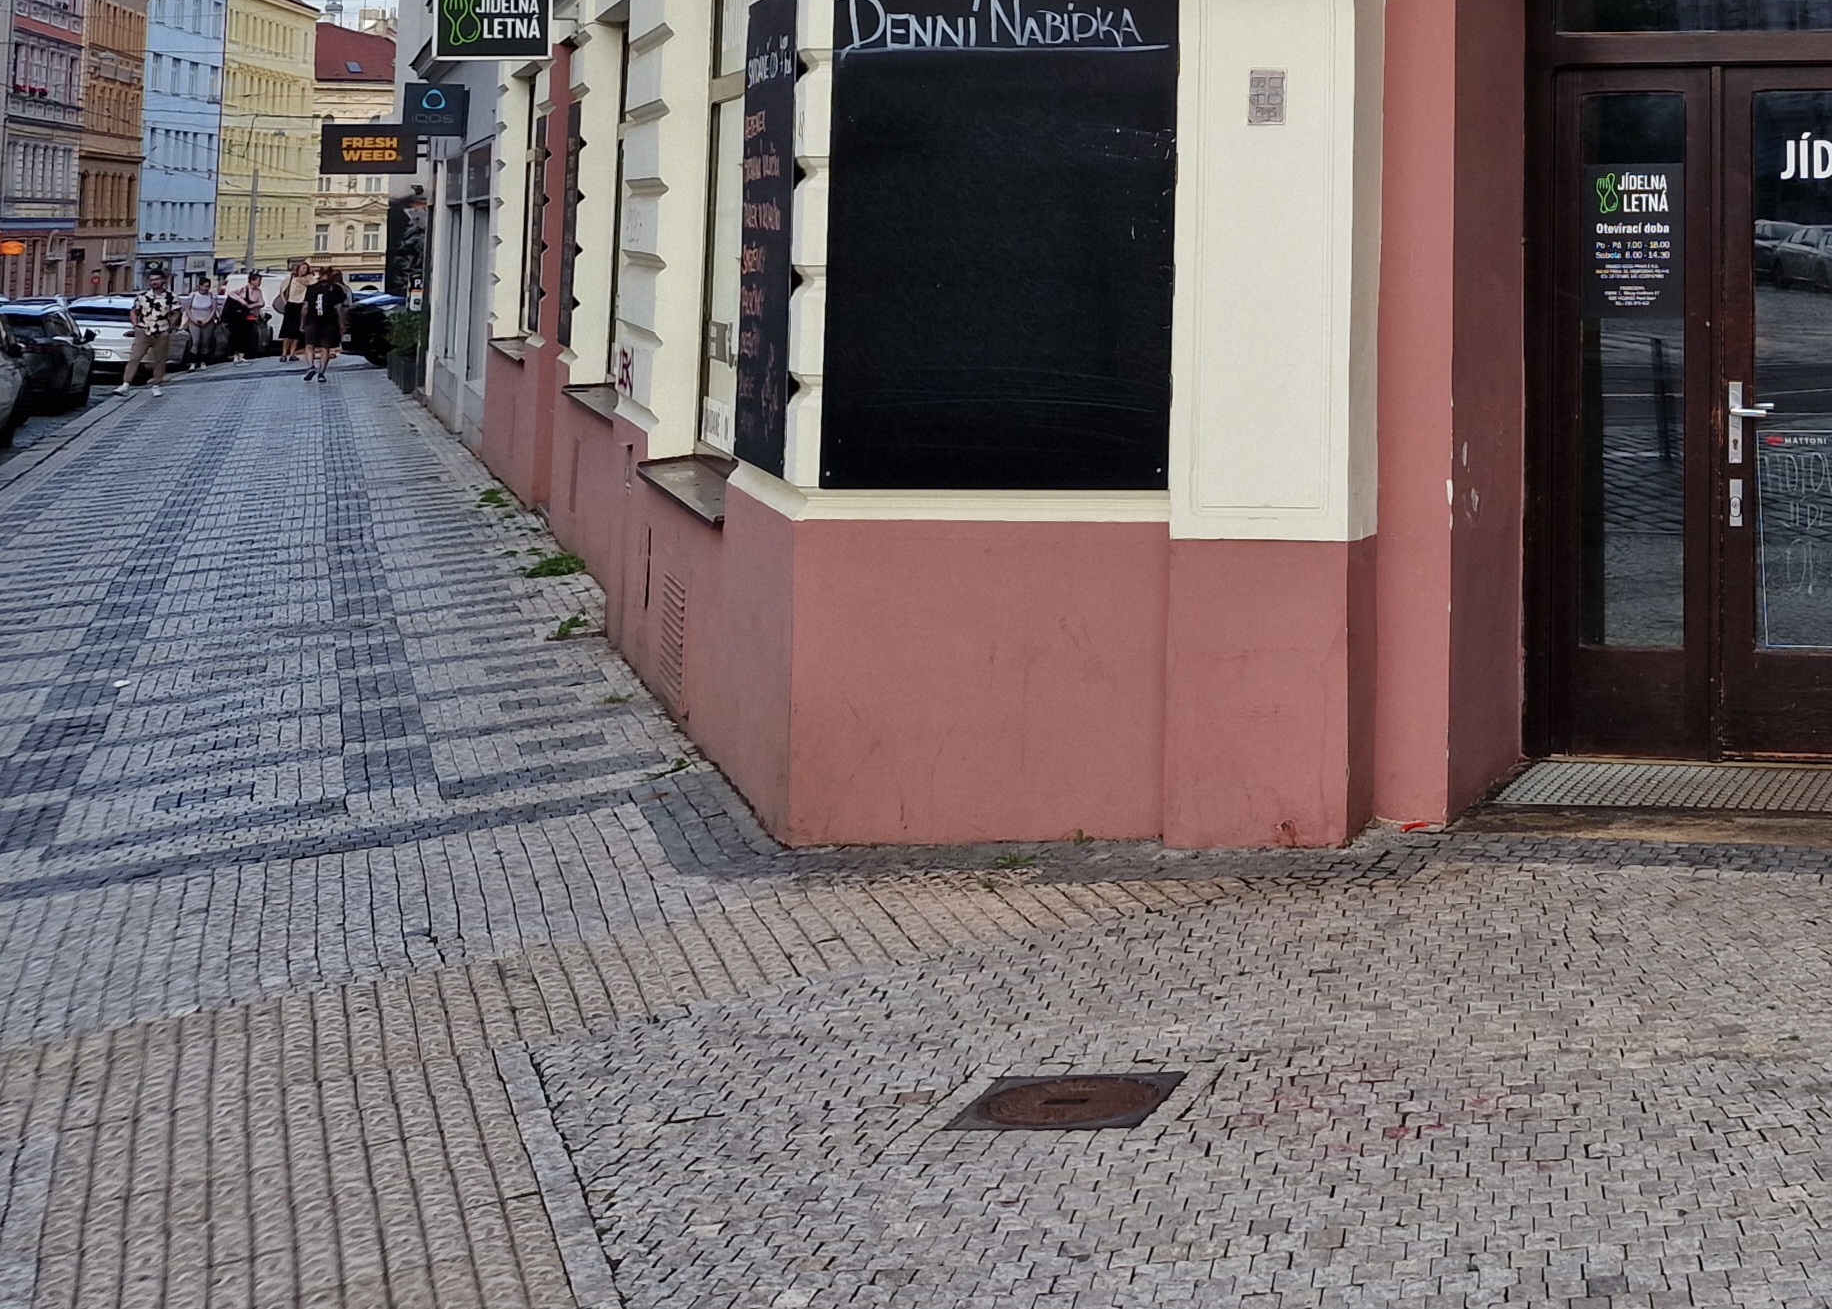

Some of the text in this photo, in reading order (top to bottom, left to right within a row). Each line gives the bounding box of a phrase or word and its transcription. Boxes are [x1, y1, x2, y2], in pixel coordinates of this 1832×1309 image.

[482, 14, 541, 39] LETNÁ
[411, 113, 454, 123] IQOS
[341, 137, 398, 148] FRESH
[1617, 172, 1668, 190] JÍDELNA
[1623, 190, 1669, 212] LETNÁ
[1596, 222, 1670, 233] Otevírací doba
[1784, 437, 1827, 445] MATTONI
